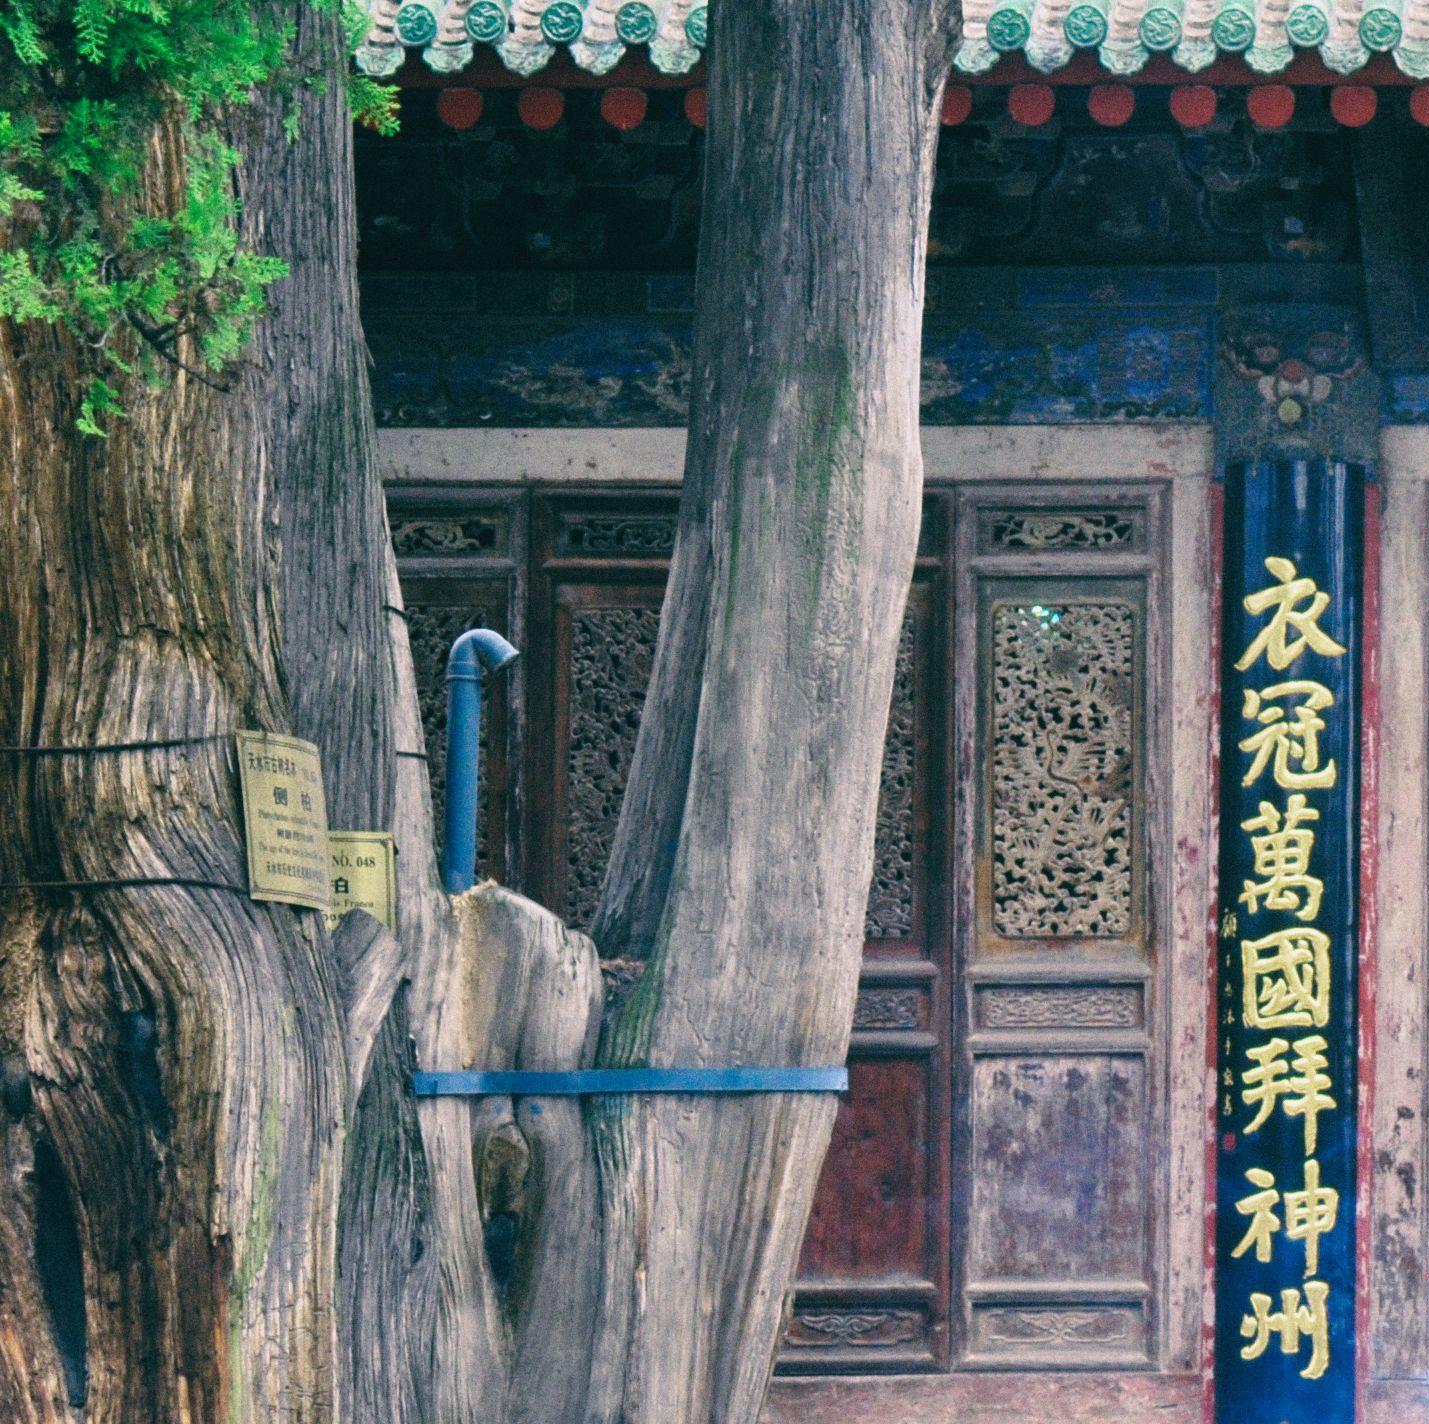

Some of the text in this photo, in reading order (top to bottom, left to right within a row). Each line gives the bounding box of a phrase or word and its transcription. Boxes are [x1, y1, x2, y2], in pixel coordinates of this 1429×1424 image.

[1235, 556, 1346, 1379] 衣冠萬國拜神州
